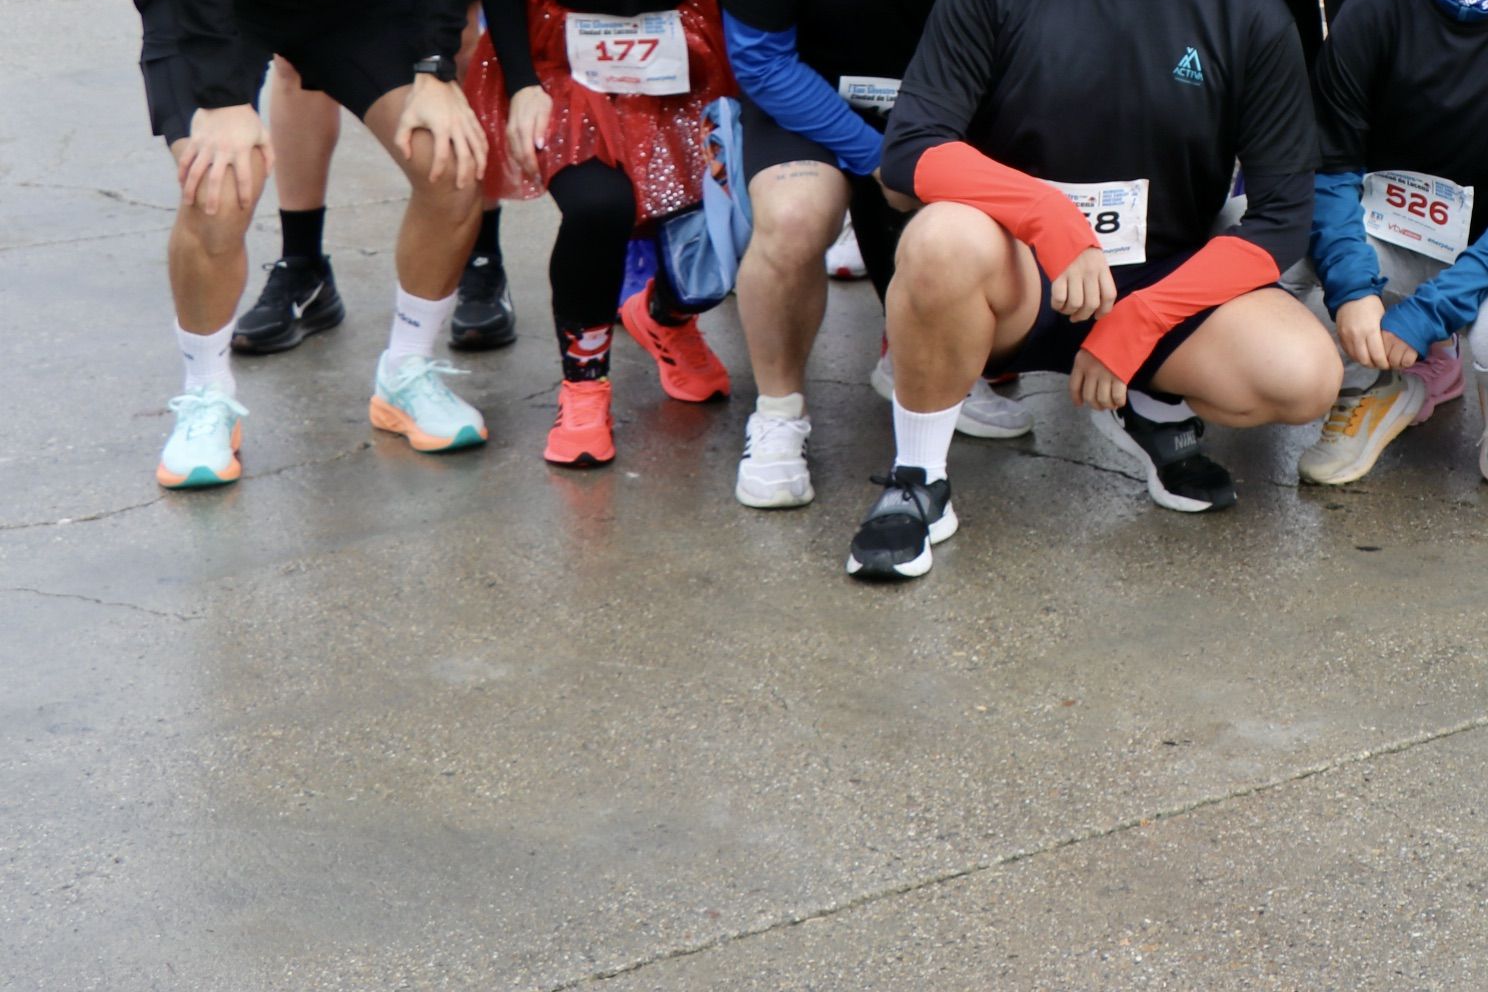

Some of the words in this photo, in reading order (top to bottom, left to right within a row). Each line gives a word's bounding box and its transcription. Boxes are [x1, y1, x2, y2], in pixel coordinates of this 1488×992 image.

[596, 39, 659, 62] 177
[1173, 67, 1203, 81] ACTIVA
[1407, 179, 1430, 192] Lucena
[1386, 183, 1449, 225] 526
